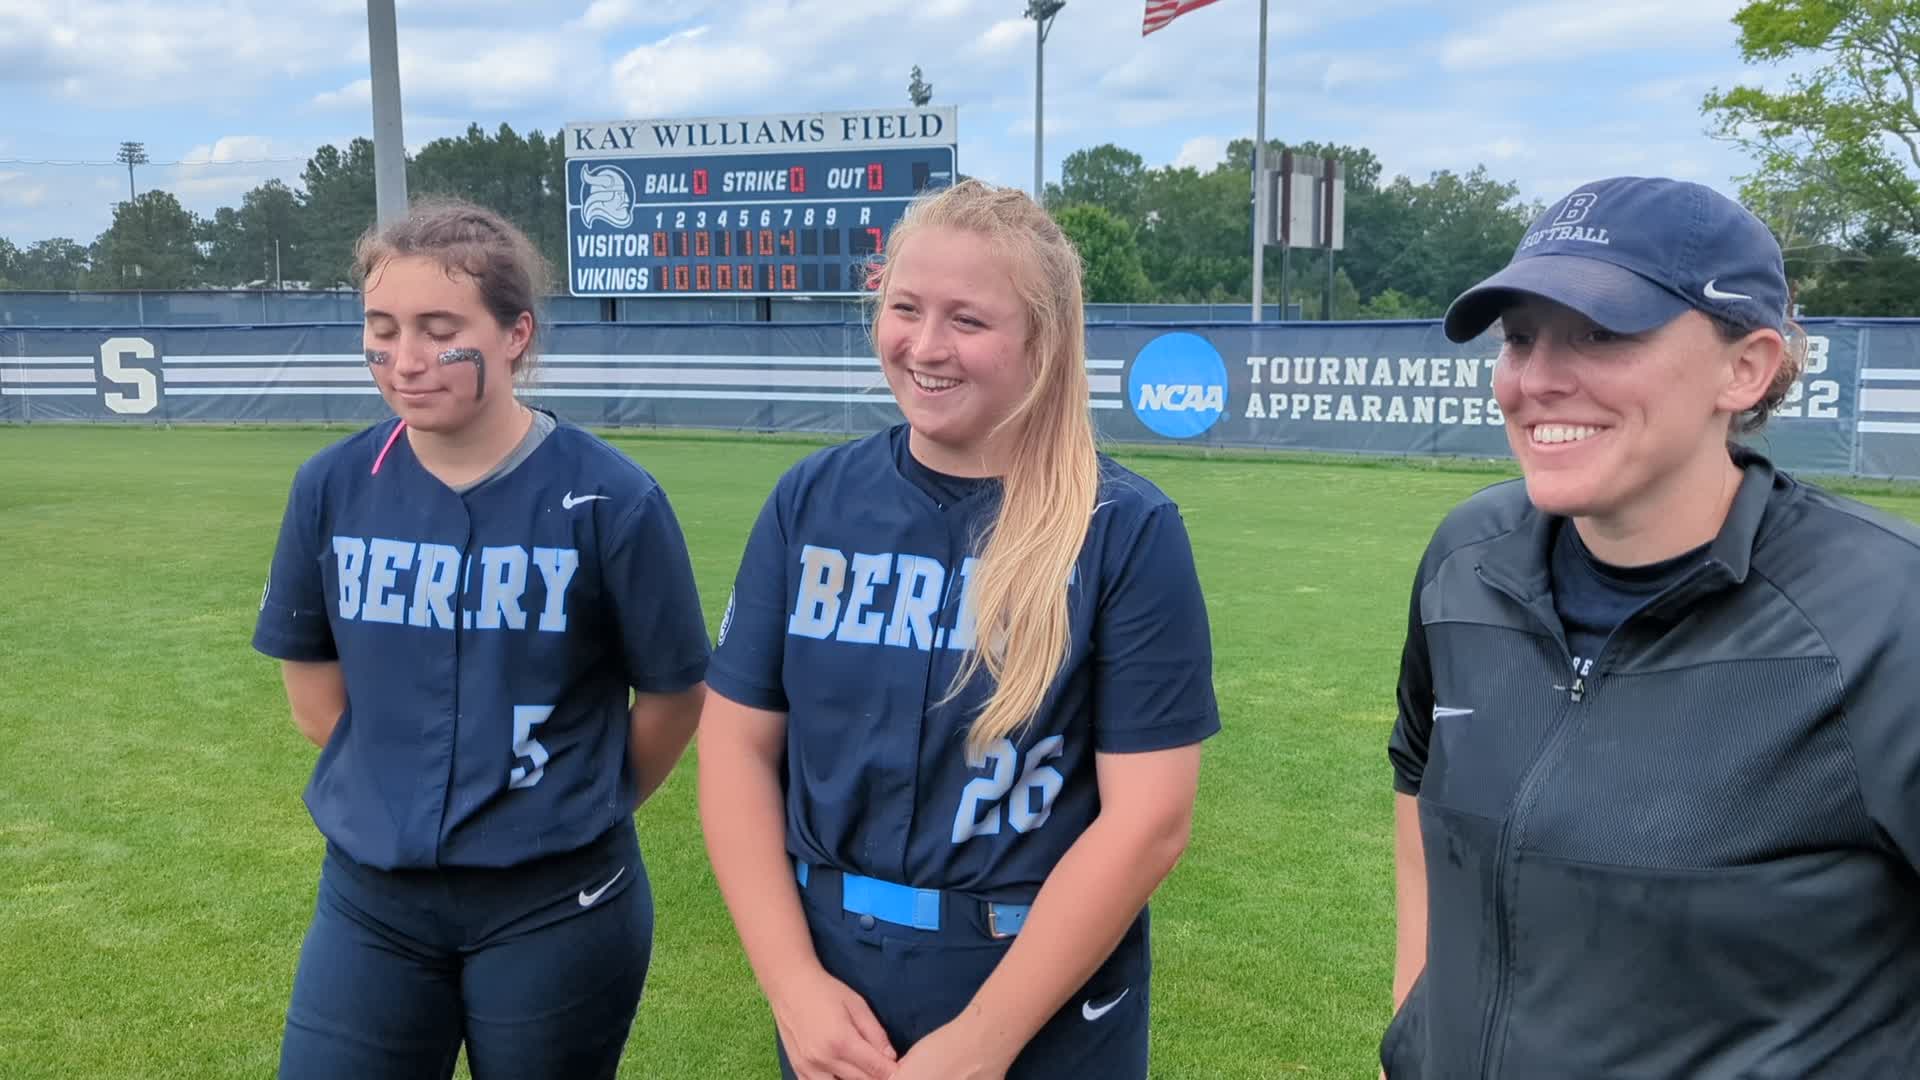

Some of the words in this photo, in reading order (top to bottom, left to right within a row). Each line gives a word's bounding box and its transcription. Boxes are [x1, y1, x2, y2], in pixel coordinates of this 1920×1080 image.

[575, 127, 638, 150] KAY
[652, 118, 826, 147] WILLIAMS
[842, 113, 943, 141] FIELD
[645, 173, 689, 194] BALL
[693, 169, 708, 195] 0
[722, 169, 788, 192] STRIKE
[790, 166, 805, 193] 0
[827, 167, 865, 189] OUT
[867, 163, 884, 191] 0
[655, 211, 663, 229] 1
[675, 211, 686, 228] 2
[696, 211, 706, 228] 3
[717, 210, 728, 227] 4
[739, 209, 749, 227] 5
[760, 209, 770, 227] 6
[783, 209, 792, 226] 7
[804, 208, 814, 226] 8
[826, 207, 836, 225] 9
[860, 207, 871, 225] R
[1552, 193, 1598, 226] B
[577, 234, 649, 257] VISITOR
[653, 232, 667, 257] 0
[682, 231, 688, 257] 1
[695, 231, 709, 257] 0
[724, 231, 730, 256] 1
[746, 230, 753, 255] 1
[759, 229, 774, 255] 0
[780, 229, 795, 255] 4
[1521, 226, 1609, 250] SOFTBALL
[577, 267, 649, 291] VIKINGS
[662, 266, 669, 290] 1
[675, 266, 689, 290] 0
[696, 265, 711, 290] 0
[717, 265, 732, 290] 0
[738, 265, 753, 289] 0
[768, 265, 775, 289] 1
[781, 264, 797, 289] 0
[101, 337, 157, 414] S
[1138, 383, 1224, 412] NCAA
[1245, 393, 1505, 426] APPEARANCES
[332, 536, 580, 632] BERRY
[788, 544, 1077, 652] BER
[509, 705, 556, 790] 5
[952, 734, 1064, 845] 26
